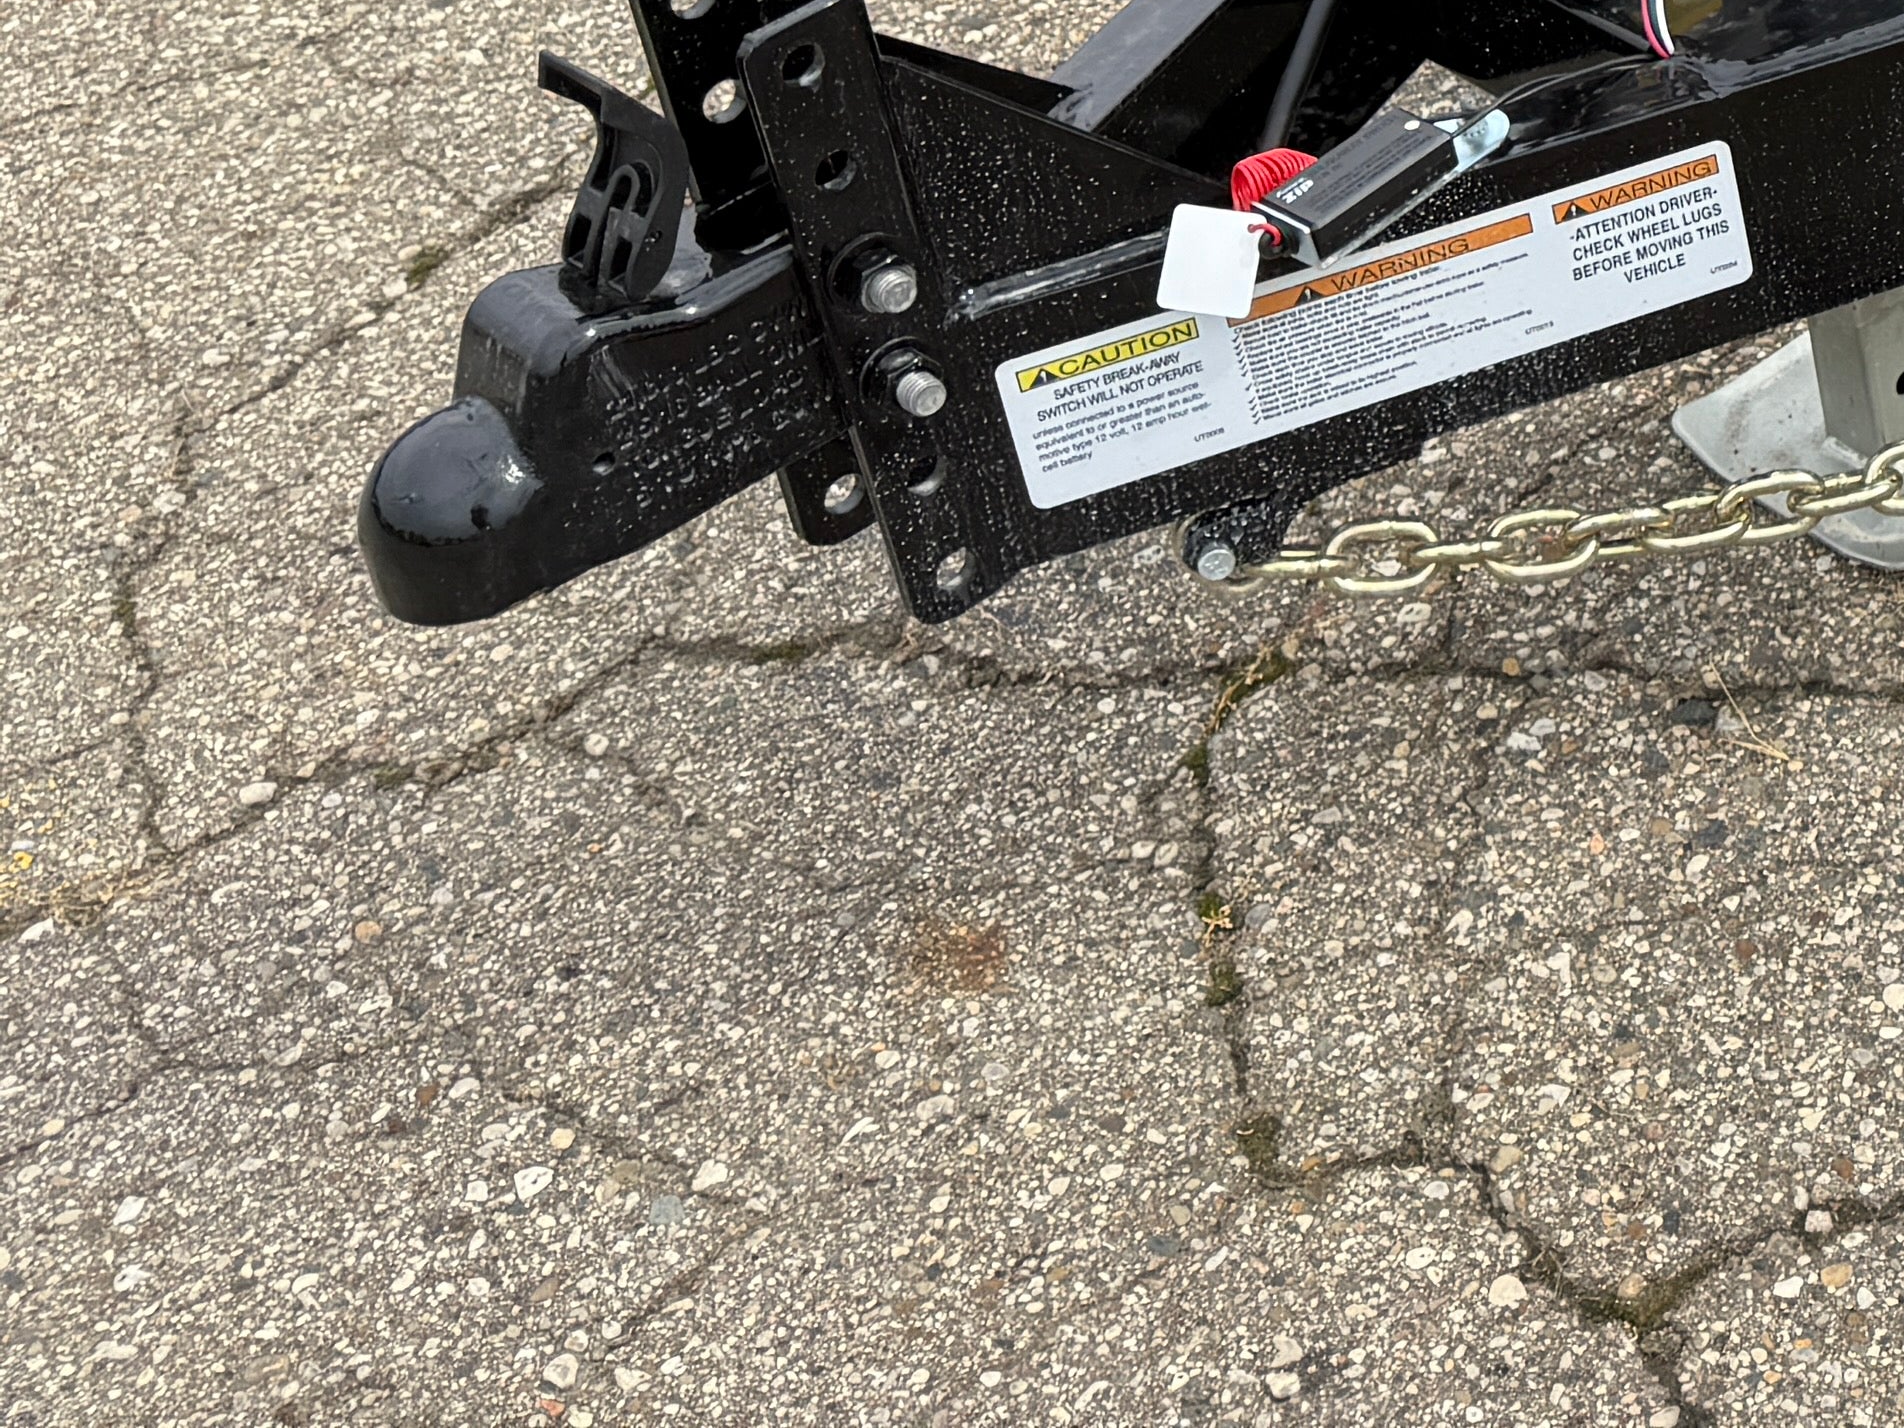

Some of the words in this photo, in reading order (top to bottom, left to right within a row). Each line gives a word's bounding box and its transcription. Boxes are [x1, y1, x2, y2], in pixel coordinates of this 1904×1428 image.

[1589, 161, 1712, 210] WARNING
[1572, 251, 1633, 281] BEFORE
[1636, 232, 1693, 261] MOVING
[1696, 220, 1730, 241] THIS
[1573, 234, 1624, 262] CHECK
[1627, 217, 1680, 244] WHEEL
[1682, 203, 1723, 227] LUGS
[1331, 237, 1470, 292] WARNING
[1624, 253, 1686, 284] VEHICLE
[1059, 322, 1193, 376] CAUTION
[1037, 396, 1087, 422] SWITCH
[1089, 388, 1119, 412] WILL
[1120, 380, 1145, 396] NOT
[1147, 360, 1204, 388] OPERATE
[1053, 377, 1101, 400] SAFETY
[1103, 351, 1181, 386] BREAK-AWAY
[1065, 407, 1114, 429] connected
[1137, 391, 1165, 409] power
[1060, 451, 1093, 469] battery
